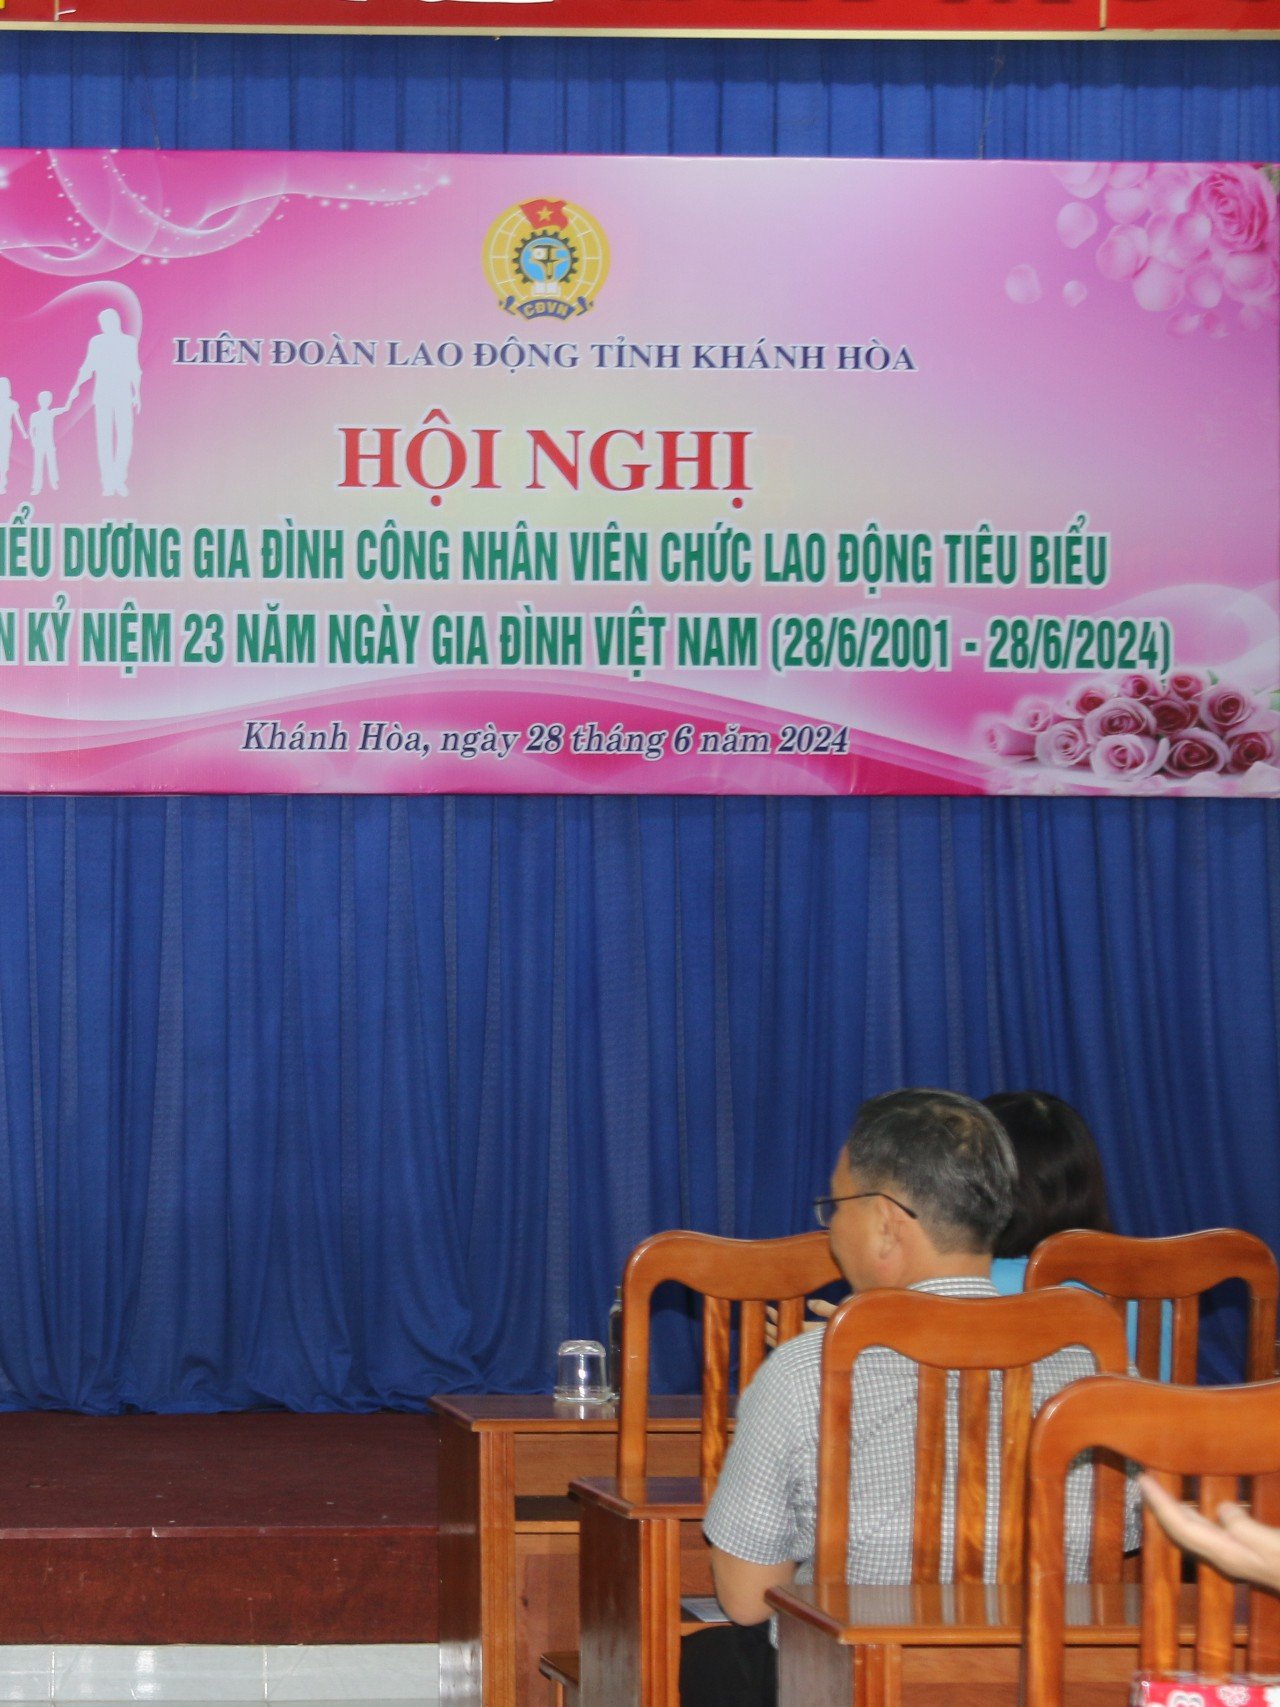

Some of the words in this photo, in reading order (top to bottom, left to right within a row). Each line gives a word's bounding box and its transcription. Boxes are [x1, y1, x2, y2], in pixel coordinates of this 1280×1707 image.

[174, 332, 261, 366] LIÊN
[272, 334, 376, 368] ĐOÀN
[386, 341, 463, 369] LAO
[474, 336, 579, 377] ĐỘNG
[590, 334, 682, 370] TỈNH
[692, 336, 825, 371] KHÁNH
[835, 337, 916, 372] HÒA
[337, 408, 503, 507] HỘI
[525, 429, 755, 509] NGHỊ
[64, 520, 180, 579] DƯƠNG
[193, 527, 251, 579] GIA
[261, 519, 343, 579] ĐÌNH
[357, 521, 449, 580] CÔNG
[462, 521, 558, 581] NHÂN
[570, 522, 647, 582] VIÊN
[660, 522, 751, 583] CHỨC
[764, 533, 826, 583] LAO
[838, 524, 932, 594] ĐỘNG
[944, 525, 1017, 585] TIÊU
[1030, 515, 1107, 586] BIỂU
[28, 595, 71, 661] KỶ
[83, 603, 171, 674] NIỆM
[184, 613, 222, 663] 23
[237, 604, 316, 664] NĂM
[329, 605, 421, 664] NGÀY
[432, 615, 488, 665] GIA
[500, 604, 582, 666] ĐÌNH
[594, 607, 667, 677] VIỆT
[677, 617, 757, 666] NAM
[771, 618, 950, 673] (28/6/2001
[965, 641, 978, 651] -
[988, 619, 1172, 675] 28/6/2024)
[243, 722, 347, 751] Khánh
[360, 724, 431, 759] Hòa,
[441, 725, 520, 758] ngày
[526, 726, 563, 752] 28
[573, 726, 664, 758] tháng
[675, 727, 691, 752] 6
[699, 727, 773, 753] năm
[780, 728, 849, 754] 2024
